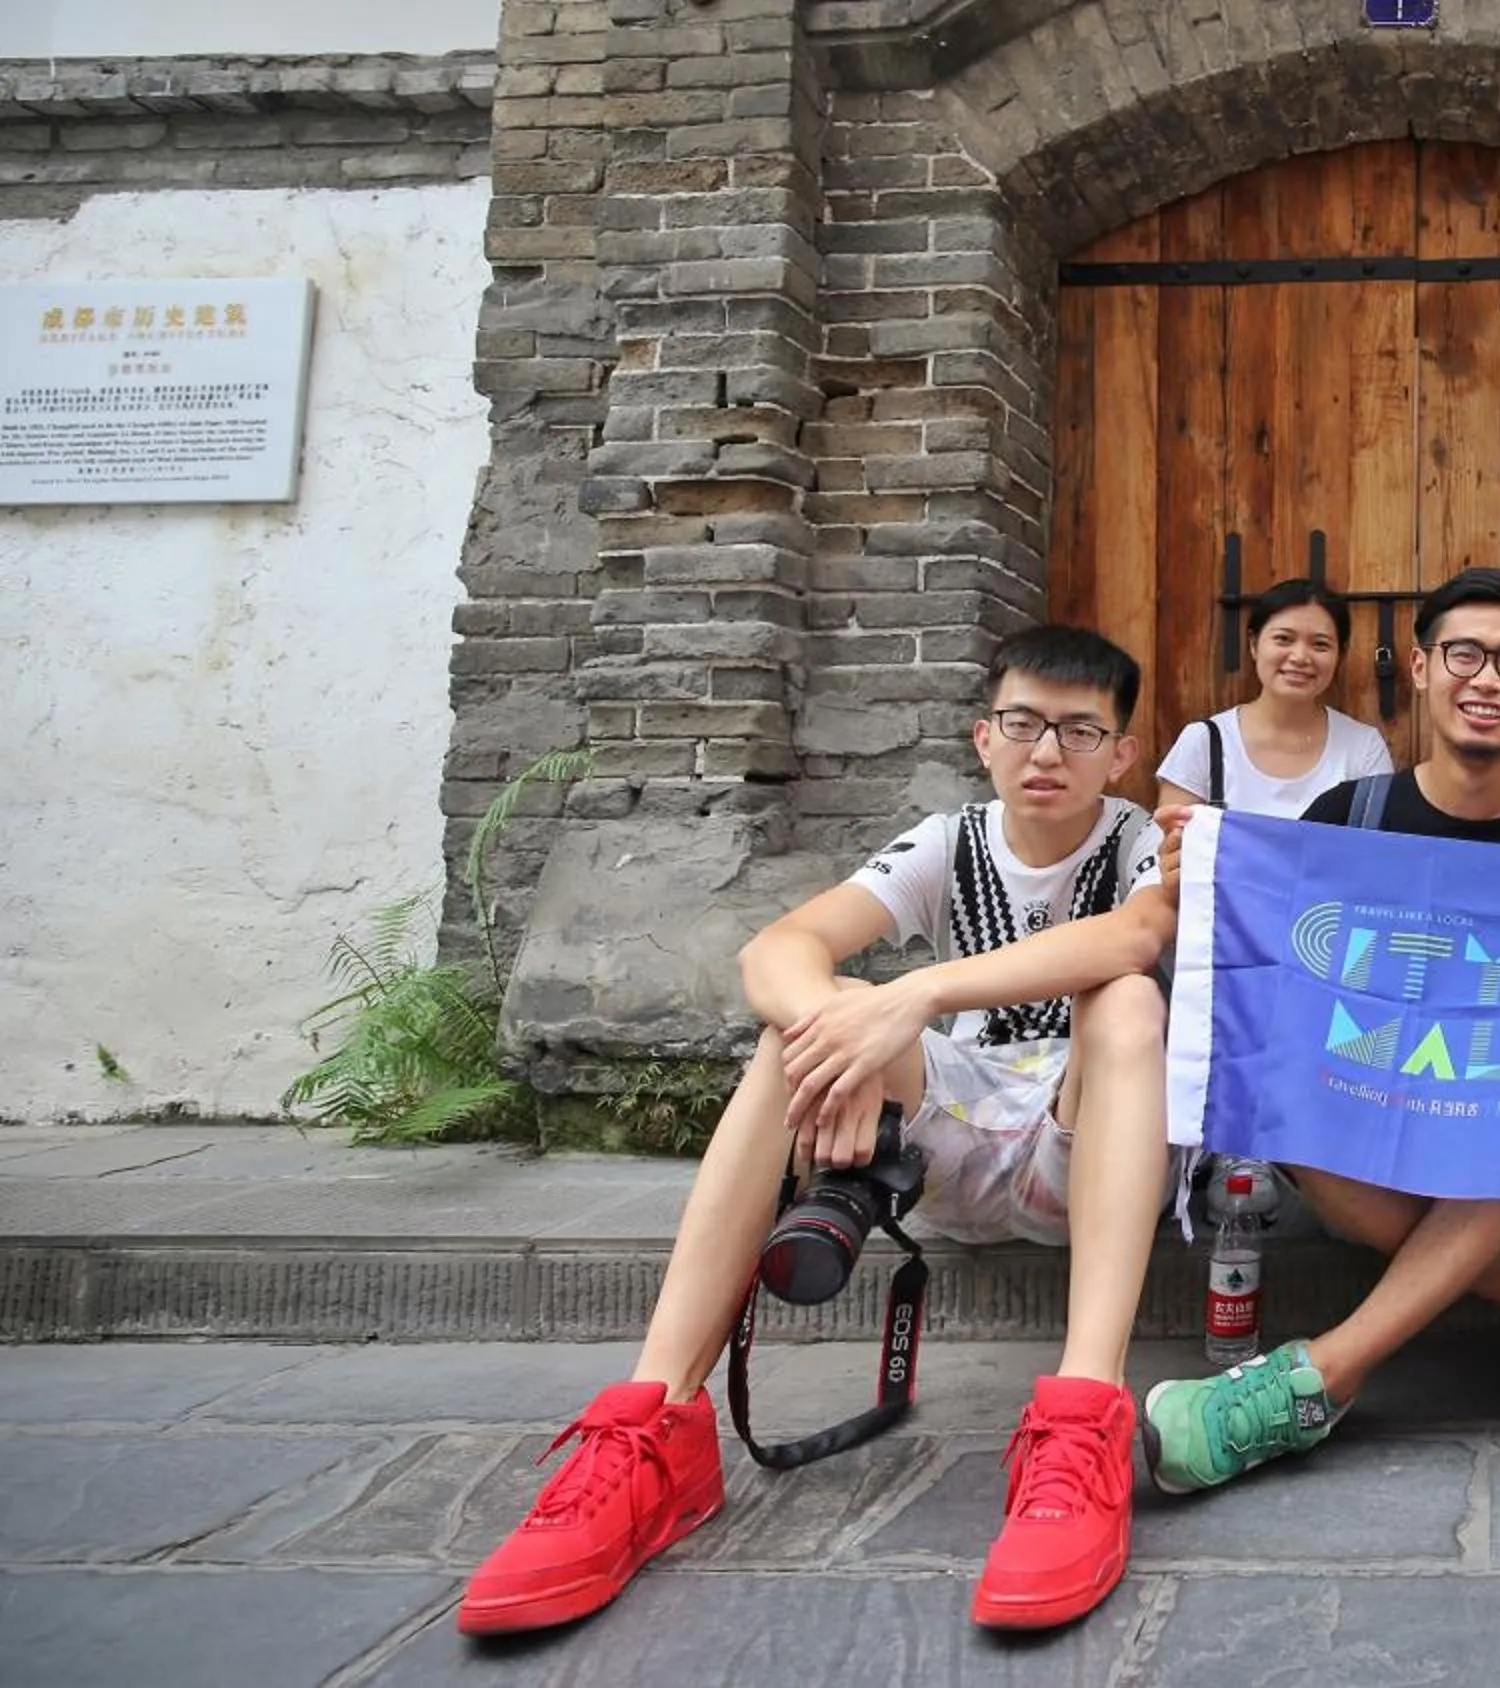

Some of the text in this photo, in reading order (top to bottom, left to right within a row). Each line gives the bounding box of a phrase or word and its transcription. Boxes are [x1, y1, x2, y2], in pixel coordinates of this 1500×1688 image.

[1354, 904, 1395, 920] TRAVEL
[1437, 914, 1474, 927] LOCAL
[892, 1303, 914, 1350] EOS
